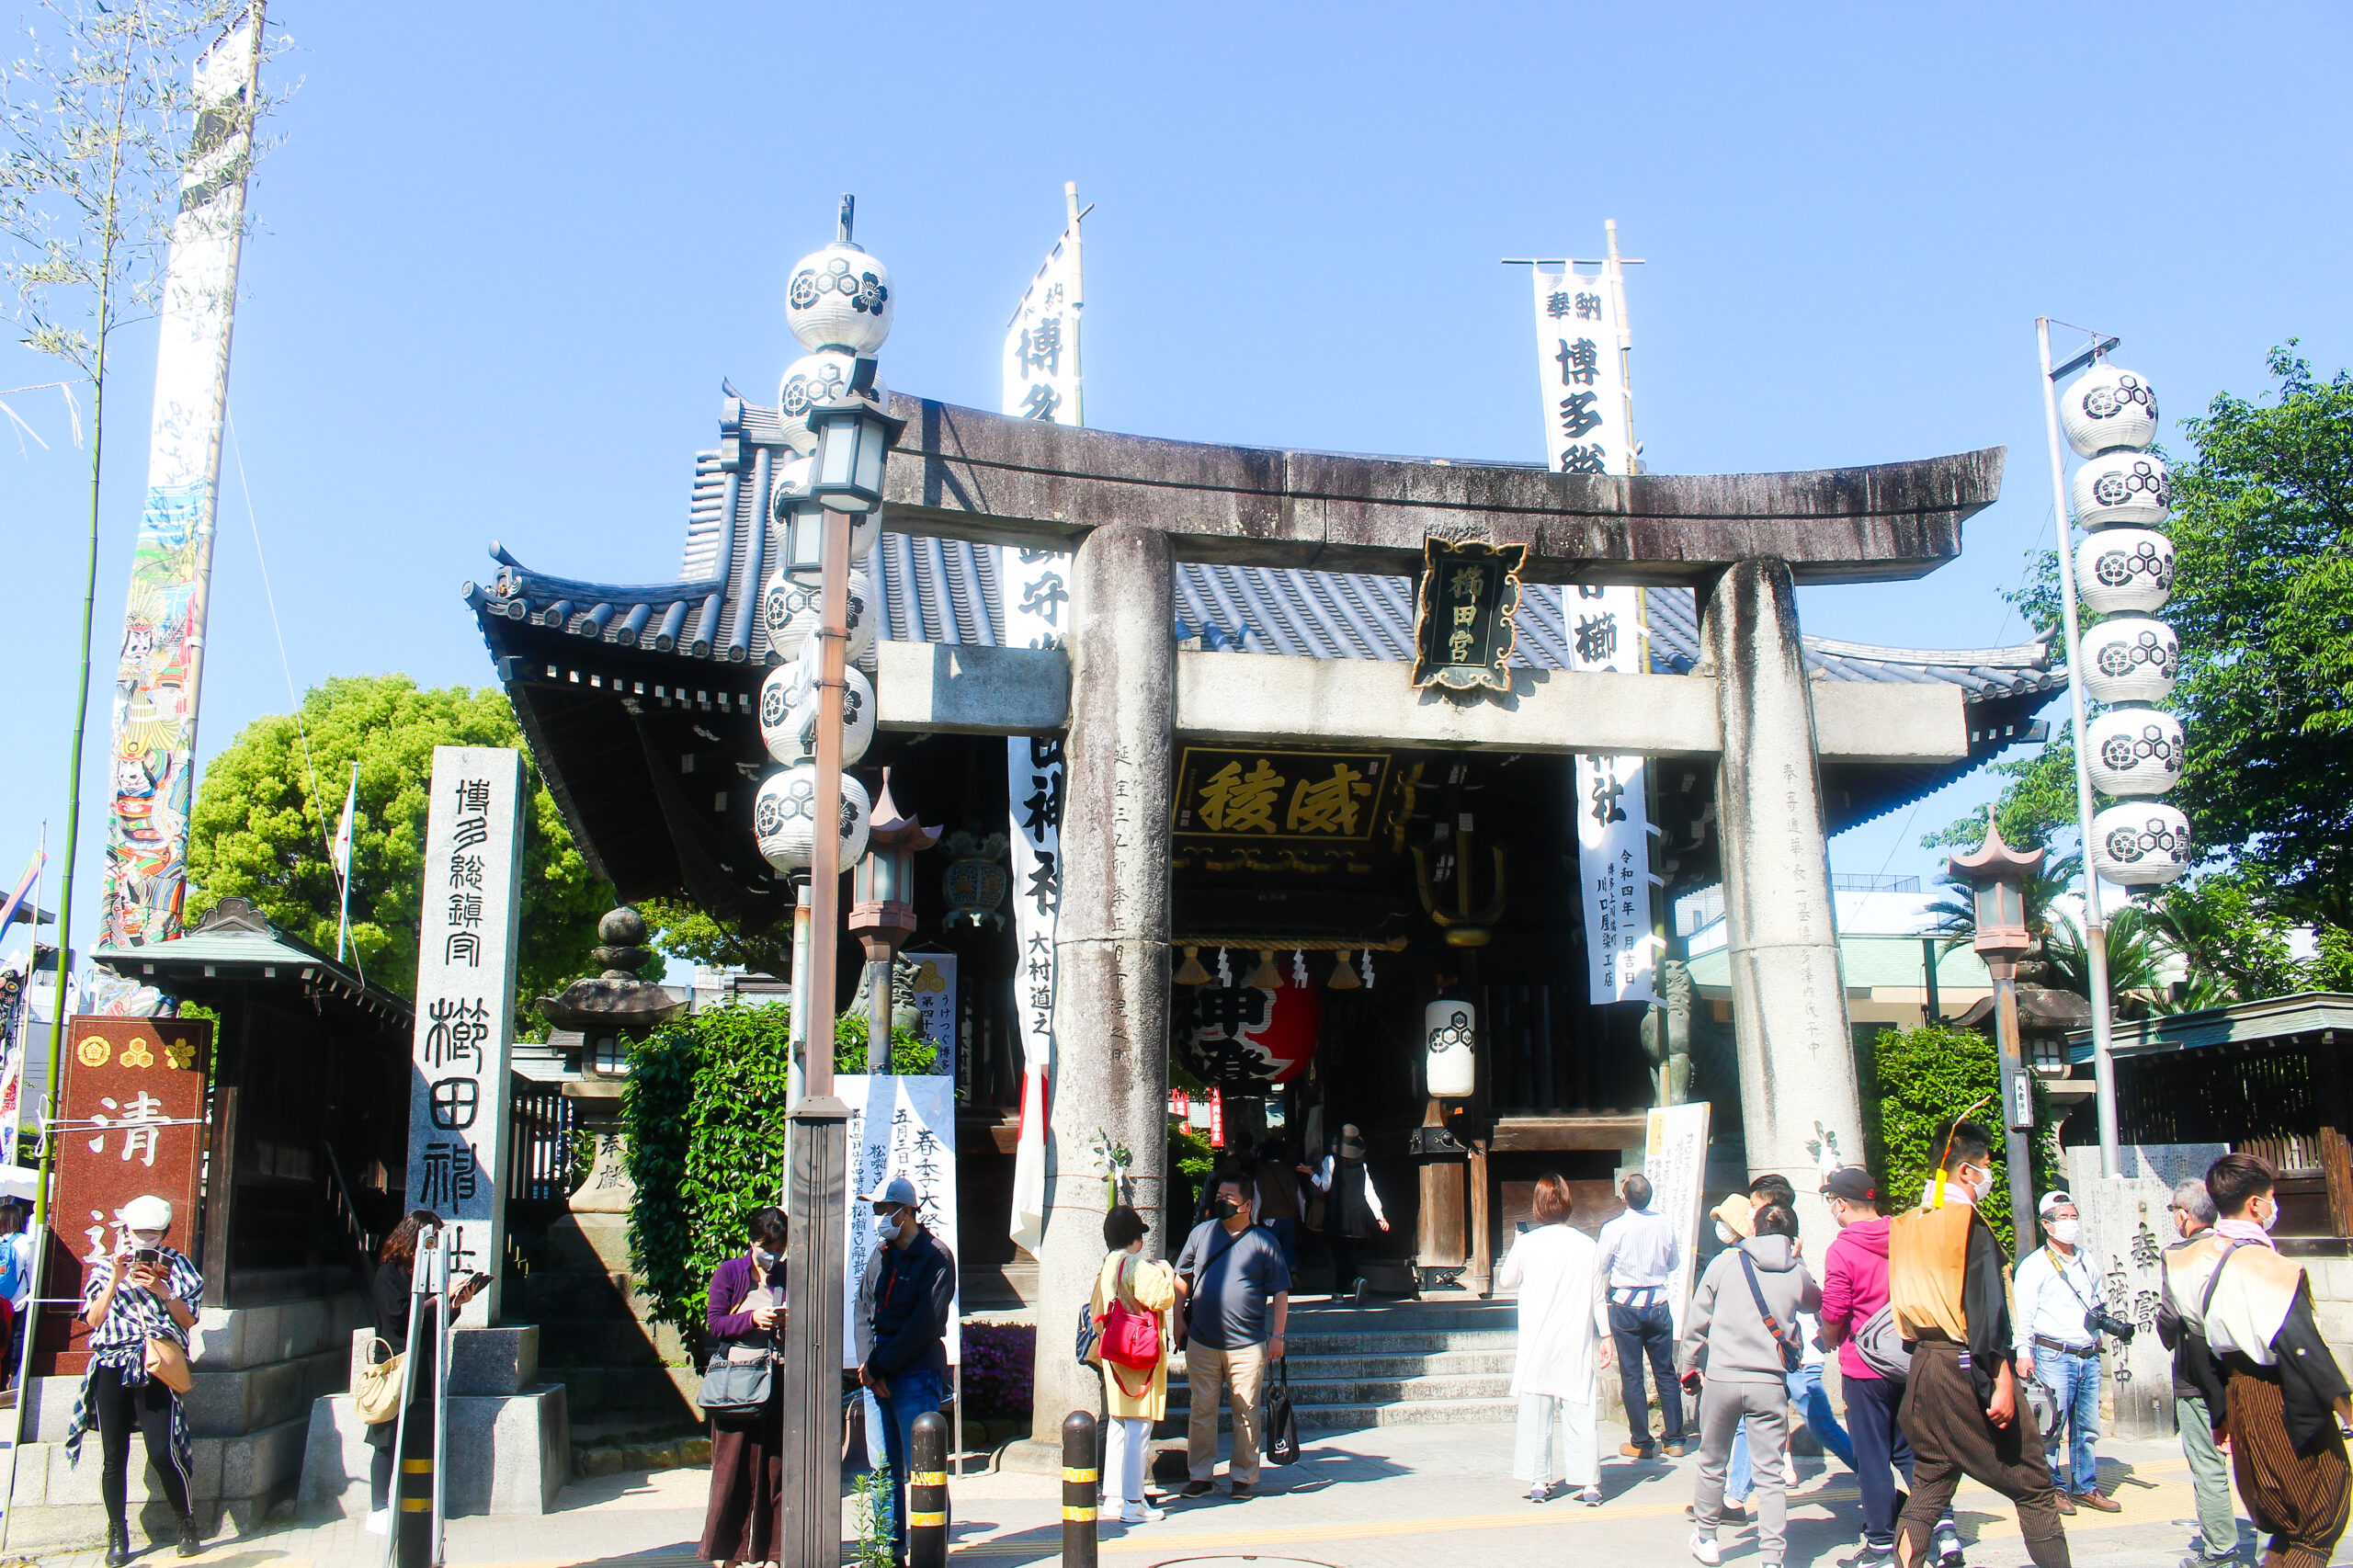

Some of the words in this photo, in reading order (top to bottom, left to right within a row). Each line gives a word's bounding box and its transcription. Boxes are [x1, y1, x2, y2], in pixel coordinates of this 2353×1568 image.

[1547, 291, 1601, 321] 奉納
[1448, 563, 1484, 663] 櫛田宮
[1597, 876, 1613, 987] 川口屋染工店
[1607, 862, 1617, 947] 博多上川端町
[1620, 848, 1635, 985] 令和四年一月吉日
[1028, 929, 1052, 1036] 大村道之
